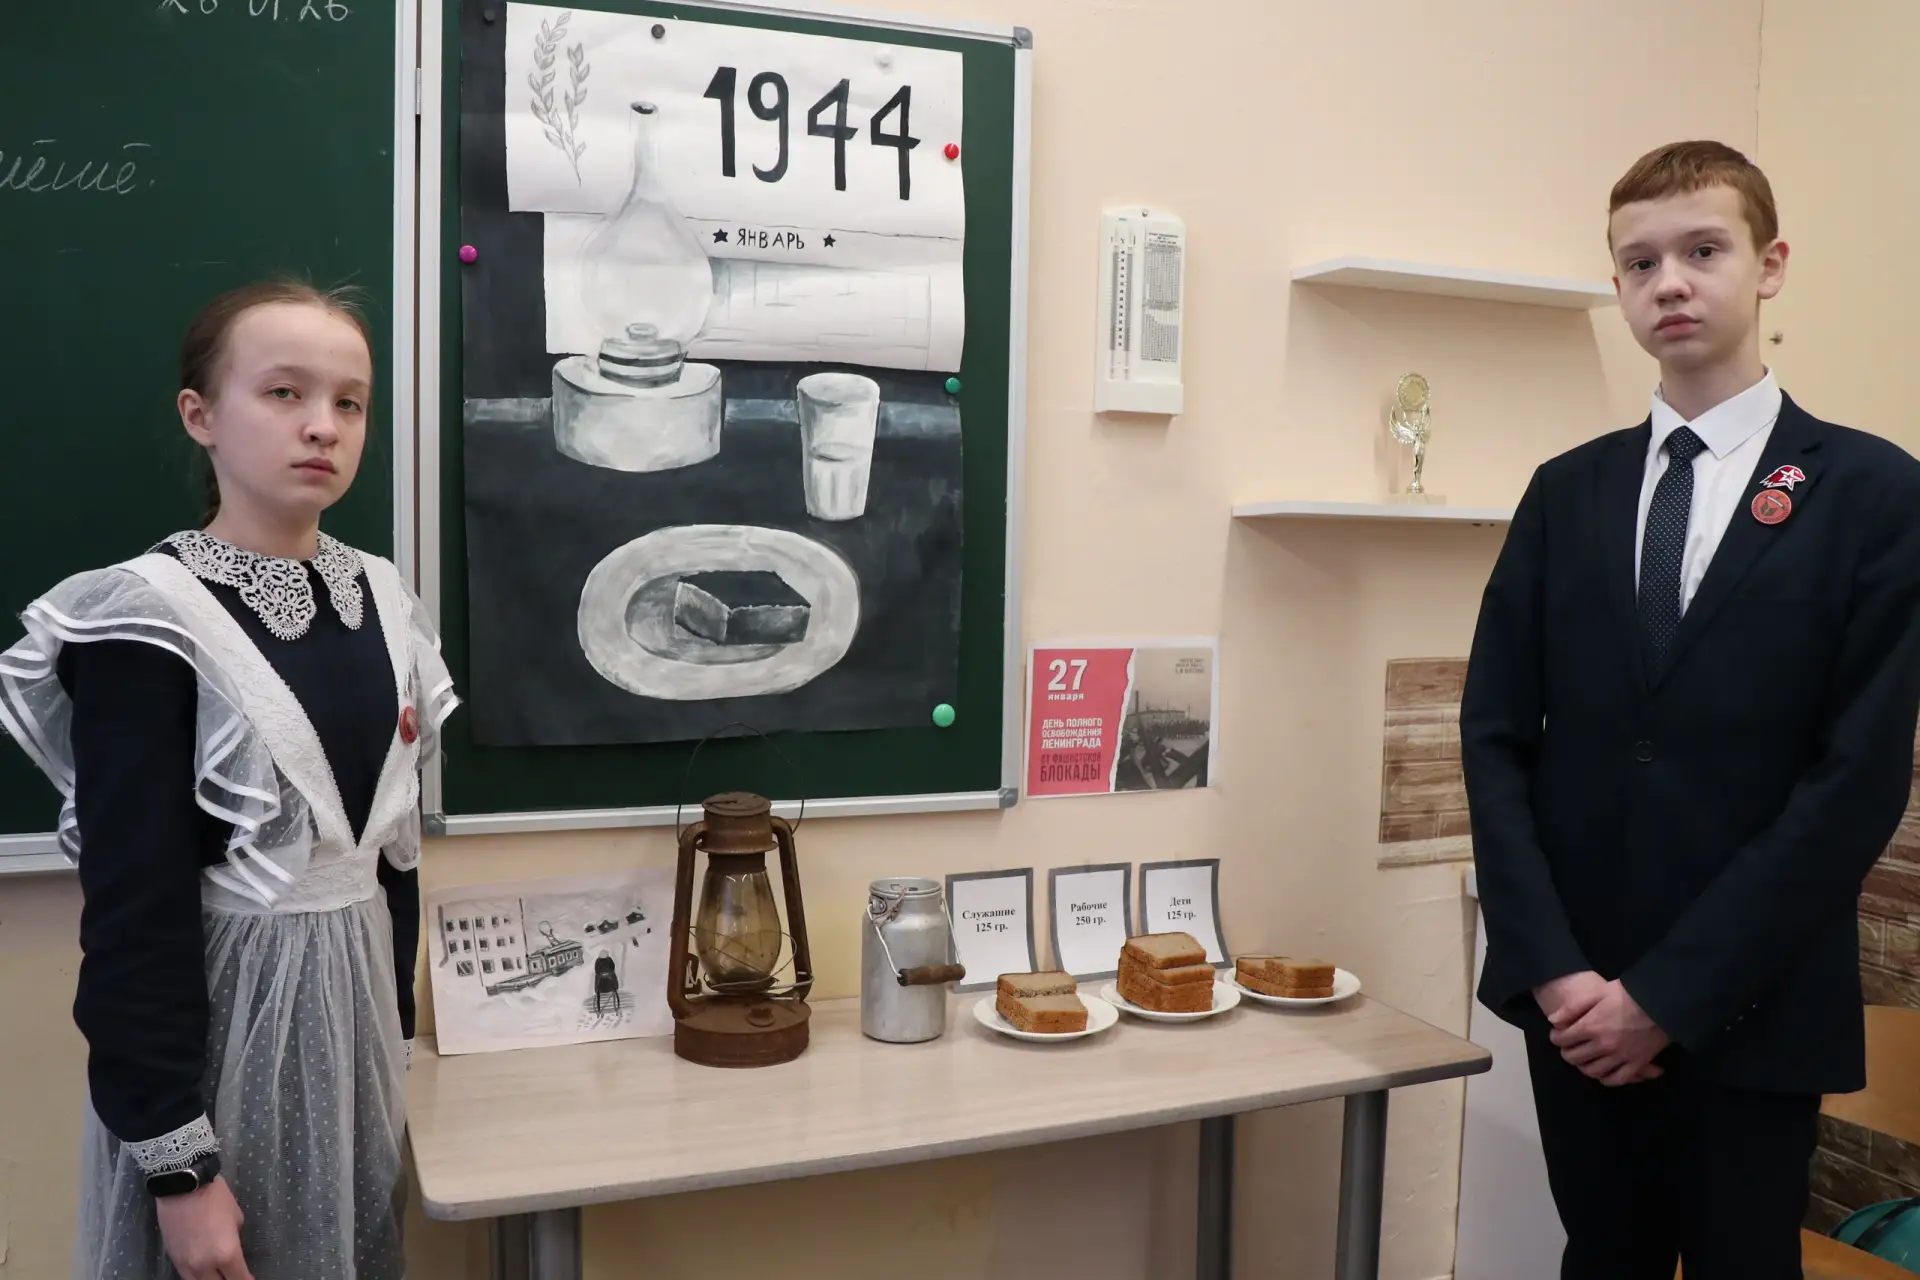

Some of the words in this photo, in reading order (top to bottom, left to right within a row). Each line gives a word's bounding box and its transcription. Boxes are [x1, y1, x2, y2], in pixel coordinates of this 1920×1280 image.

[703, 66, 921, 201] 1944
[737, 228, 805, 250] ЯНВАРЬ
[1048, 659, 1088, 691] 27
[1048, 693, 1084, 702] января
[1042, 718, 1065, 730] ДЕНЬ
[1066, 717, 1103, 728] ПОЛНОГО
[1042, 727, 1102, 738] ОСВОБОЖДЕНИЯ
[1041, 737, 1102, 749] ЛЕНИНГРАДА
[1040, 763, 1101, 783] БЛОКАДЫ
[1070, 902, 1108, 912] Рабочие
[1169, 897, 1192, 907] Дети
[1075, 916, 1091, 926] 250
[1093, 916, 1106, 926] гр.
[1167, 910, 1182, 920] 125
[1184, 911, 1197, 921] гр.
[976, 922, 992, 933] 125
[994, 923, 1009, 933] гр.
